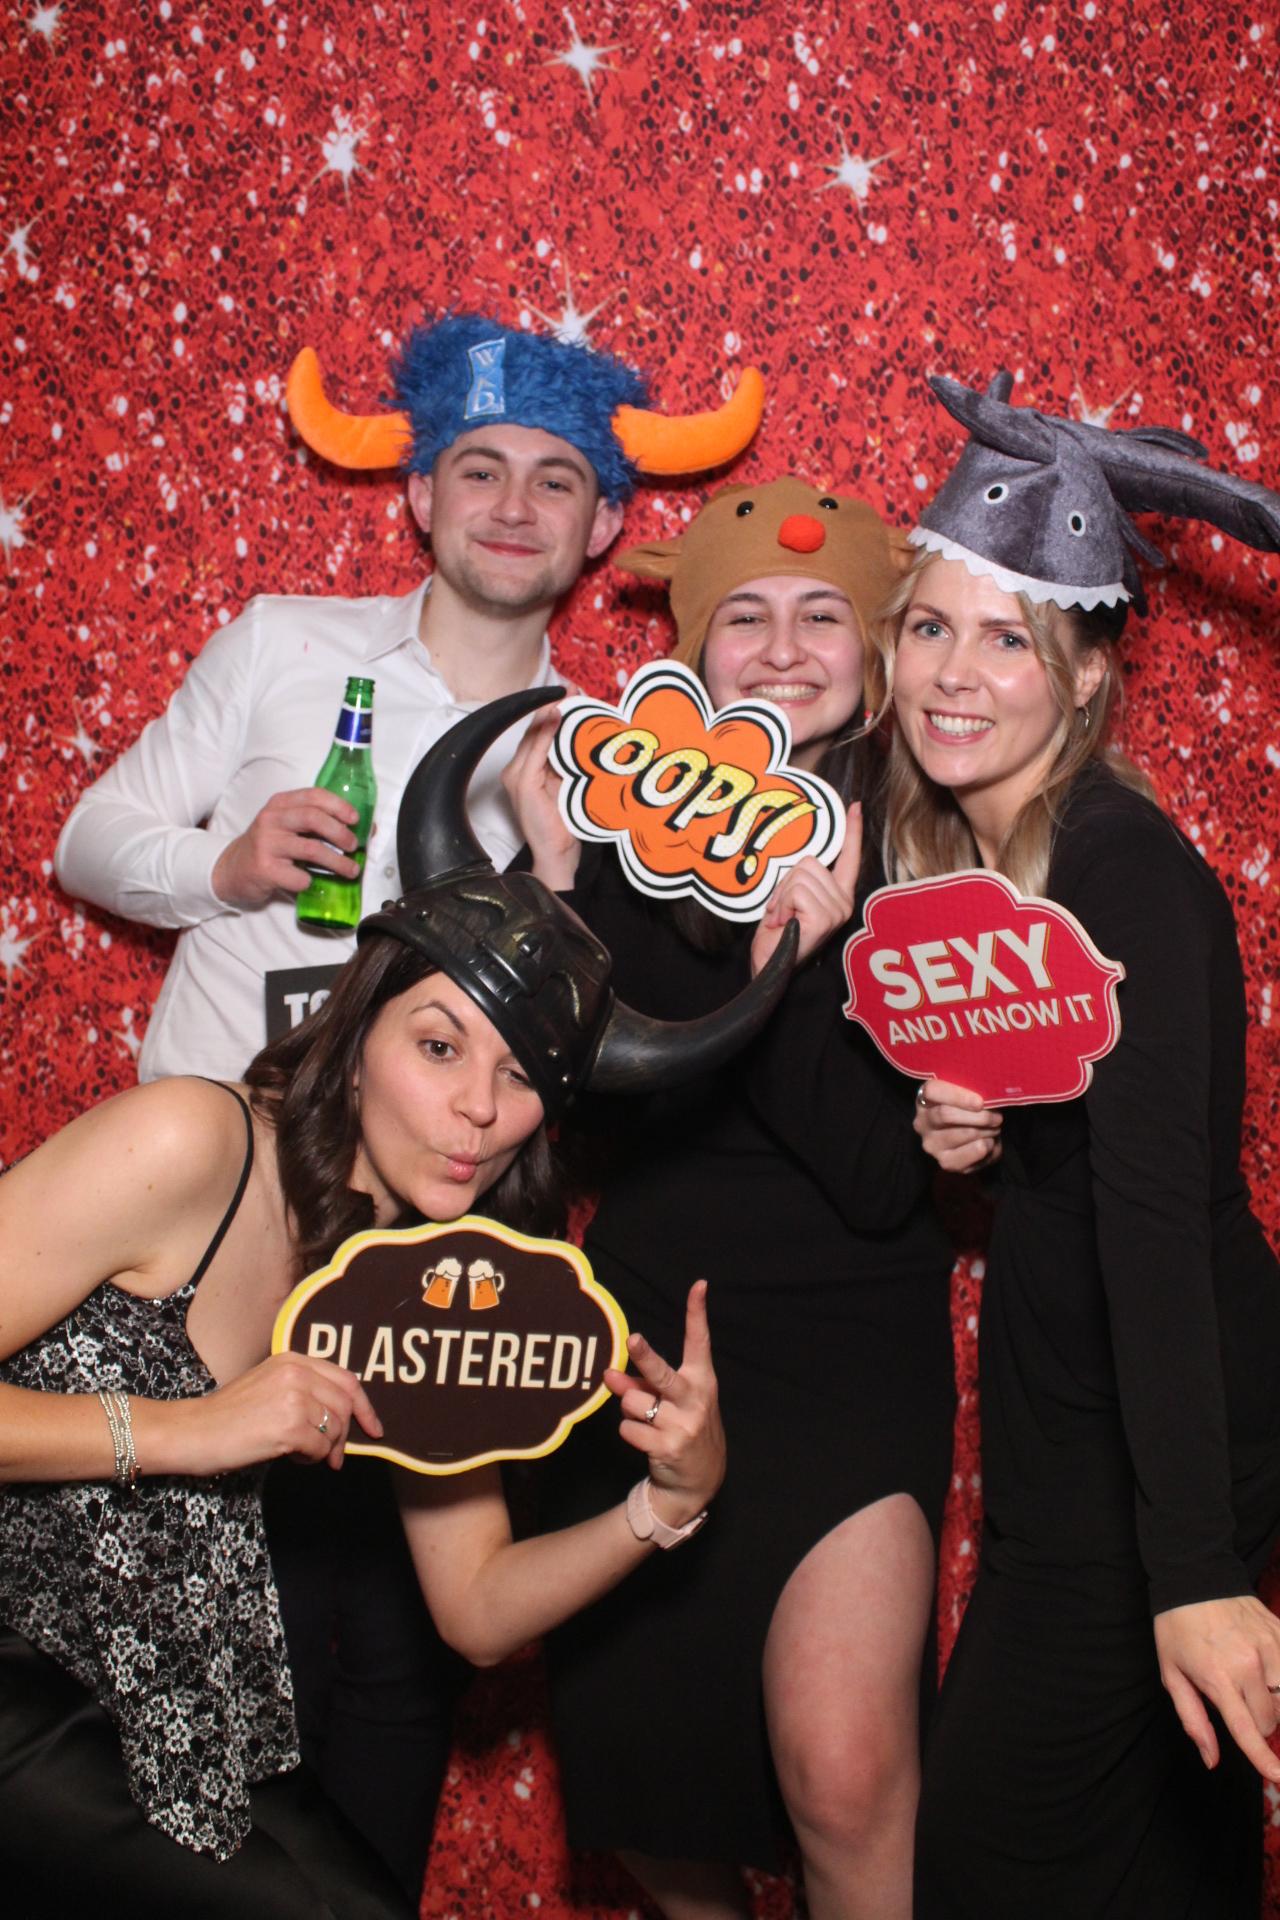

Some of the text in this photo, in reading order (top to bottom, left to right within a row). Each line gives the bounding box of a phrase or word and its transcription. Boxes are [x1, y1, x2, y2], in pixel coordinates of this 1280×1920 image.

[590, 728, 819, 885] OOPS!
[869, 922, 1055, 1010] SEXY
[888, 993, 1096, 1046] AND I KNOW IT
[307, 1323, 598, 1391] PLASTERED!
